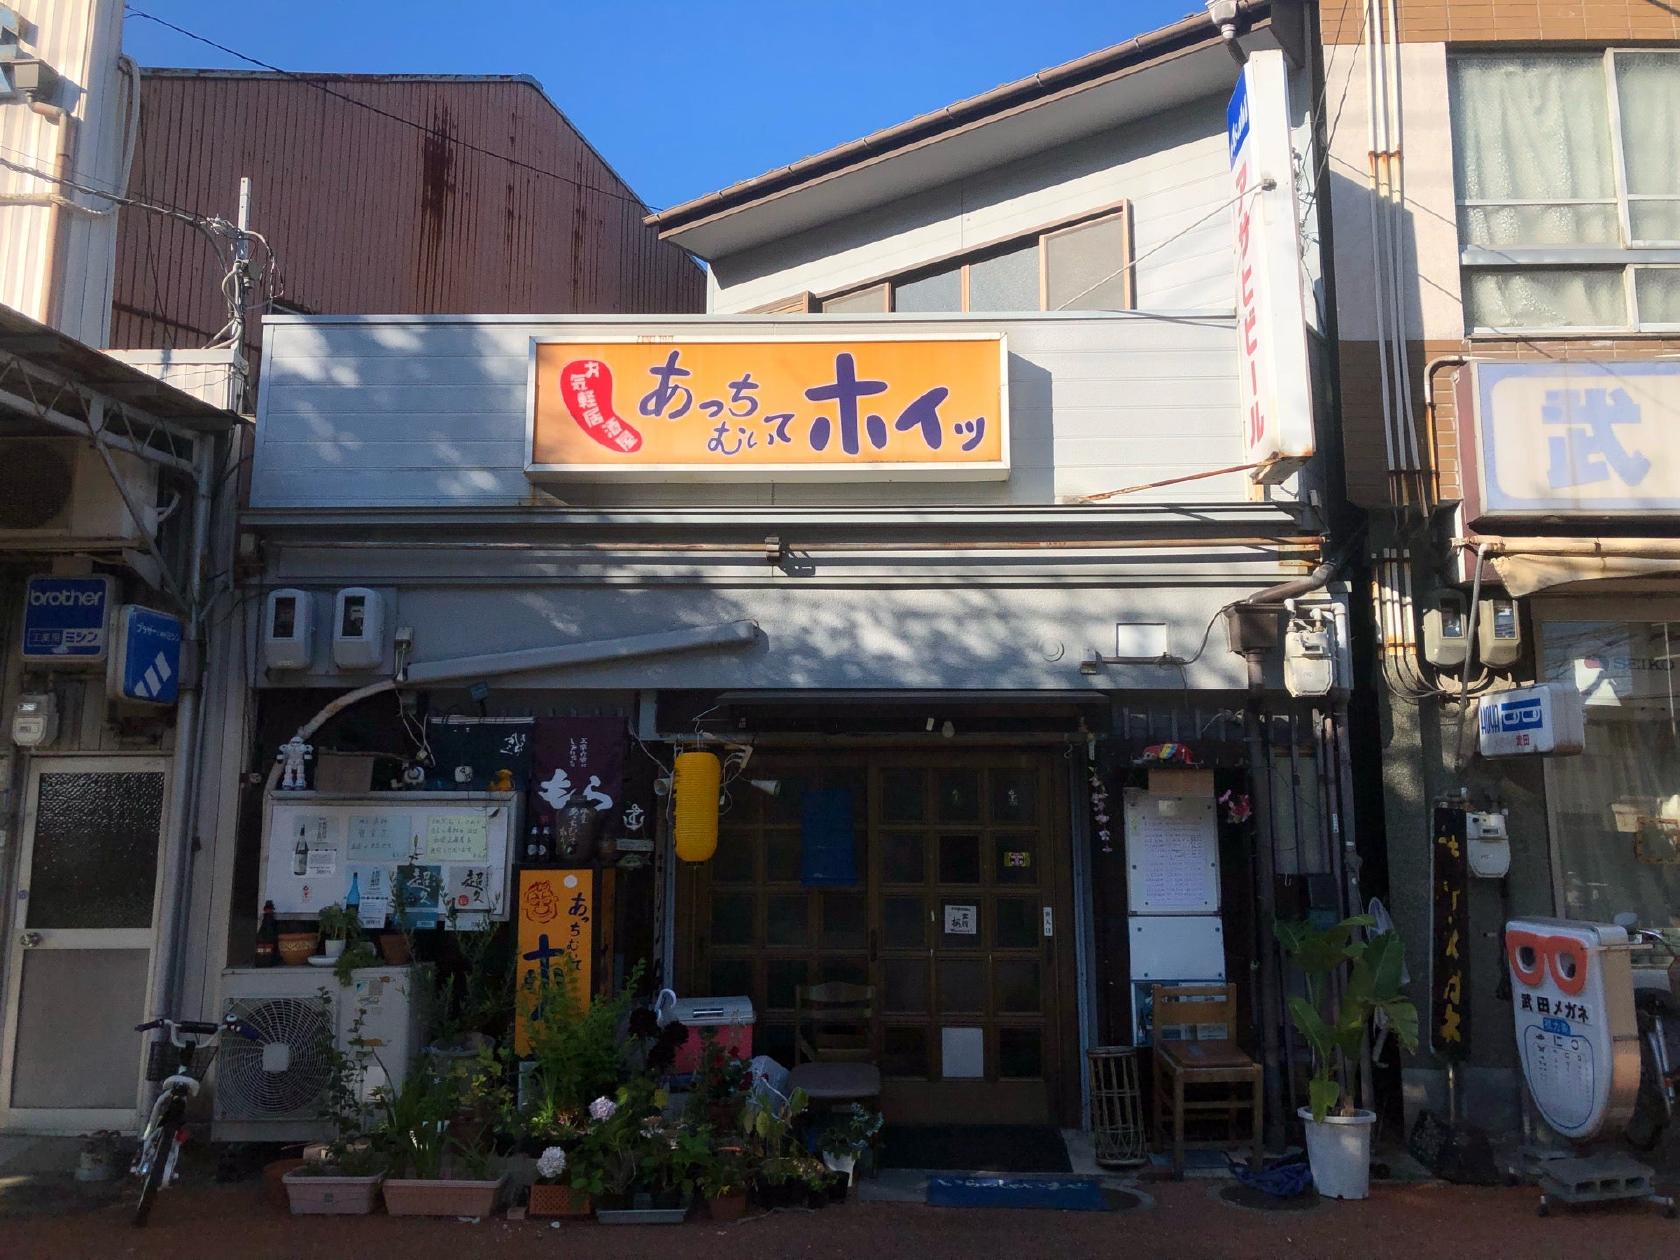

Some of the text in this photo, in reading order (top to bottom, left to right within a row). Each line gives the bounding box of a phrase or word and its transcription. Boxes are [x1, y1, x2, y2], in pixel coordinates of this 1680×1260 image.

[1236, 162, 1265, 449] アサヒビール
[30, 588, 103, 606] brother
[1612, 657, 1676, 672] SEIKO
[1480, 704, 1501, 736] HOYA
[1520, 992, 1591, 1024] 武田メガネ
